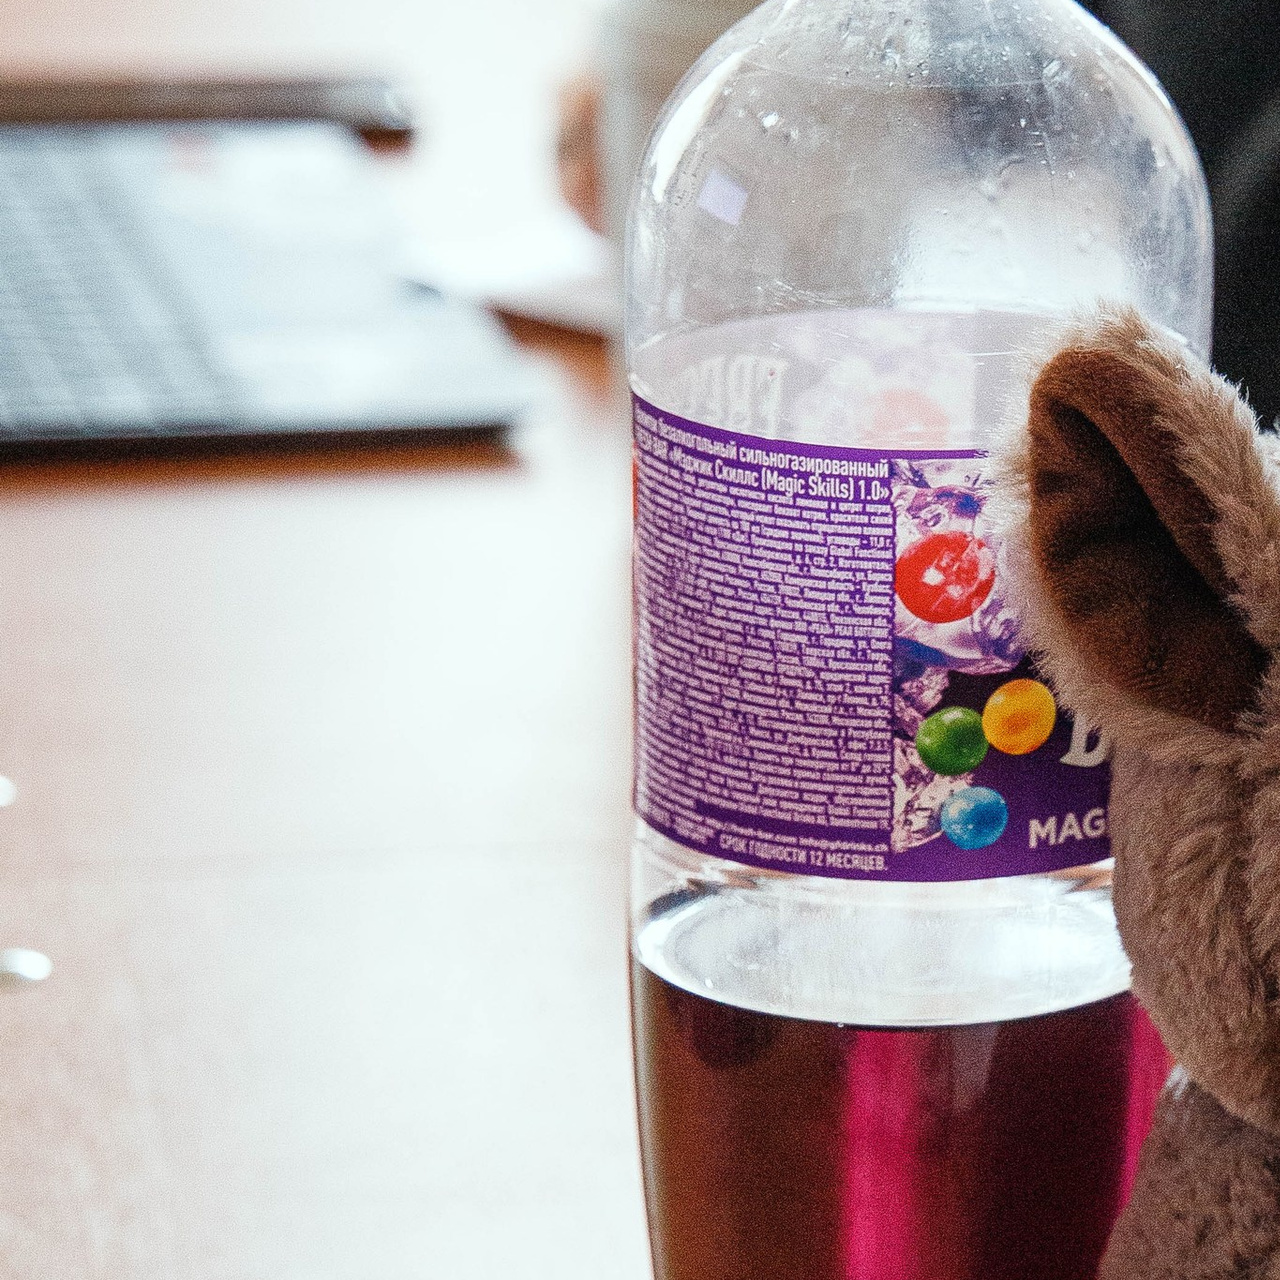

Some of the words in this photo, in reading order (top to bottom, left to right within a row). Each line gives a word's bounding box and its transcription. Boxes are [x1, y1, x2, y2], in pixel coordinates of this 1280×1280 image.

[739, 447, 889, 478] сильногазированный
[715, 459, 759, 487] Скиллс
[761, 467, 806, 497] (Magic
[808, 476, 854, 501] Skills)
[858, 480, 890, 501] 1.0»
[809, 850, 825, 867] 12
